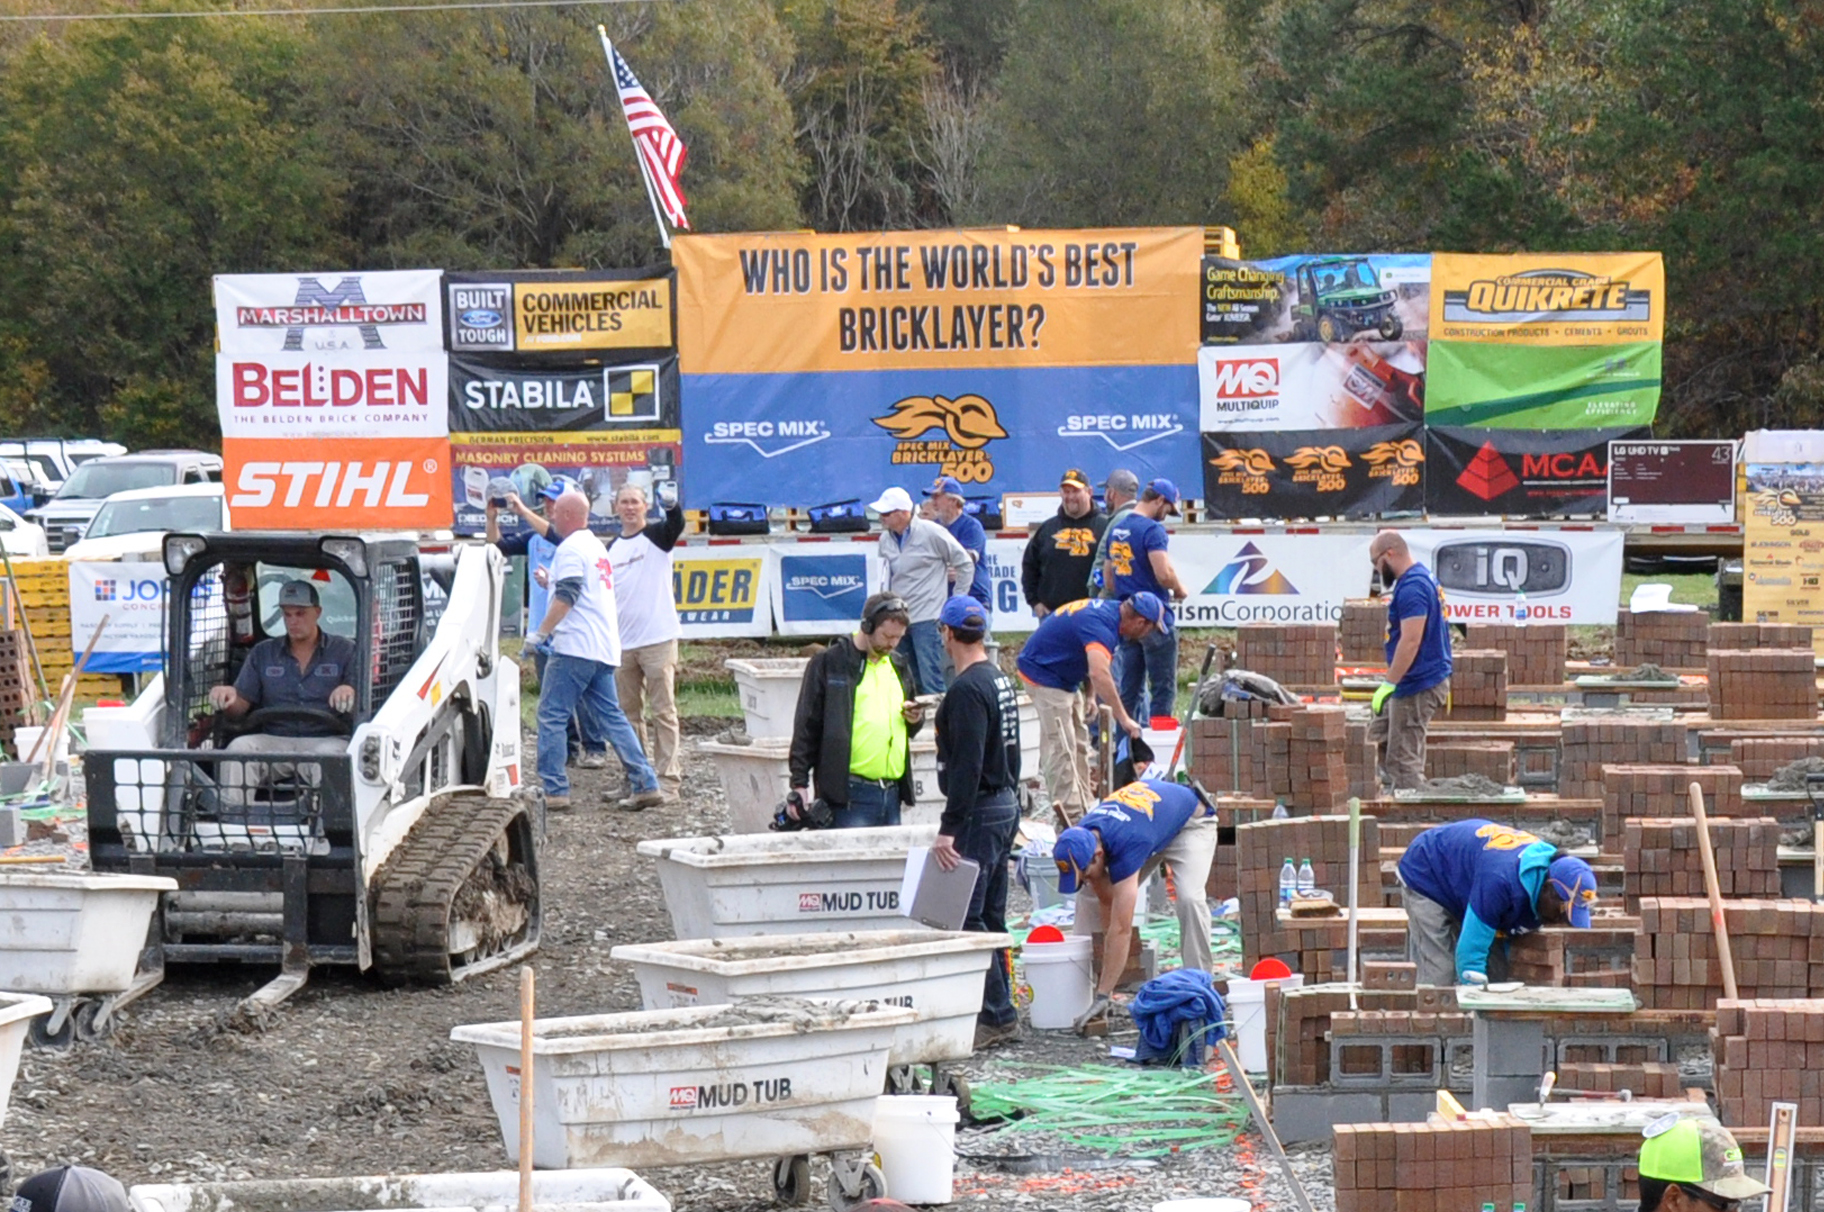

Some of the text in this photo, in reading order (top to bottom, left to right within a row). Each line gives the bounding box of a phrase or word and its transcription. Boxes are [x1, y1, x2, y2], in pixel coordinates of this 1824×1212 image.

[740, 241, 1137, 294] WHO IS THE WORLD'S BEST
[1207, 266, 1285, 287] Game Changing
[1496, 275, 1569, 288] COMMERCIAL
[456, 291, 505, 309] BUILT
[522, 290, 663, 313] COMMERCIAL
[1206, 285, 1281, 303] Craftsmanship.
[1467, 281, 1629, 312] QUIKRETE
[240, 305, 424, 325] MARSHALLTOWN
[523, 312, 622, 333] VEHICLES
[459, 329, 506, 343] TOUGH
[839, 303, 1046, 353] BRICKLAYER?
[1443, 327, 1506, 337] CONSTRUCTION
[1507, 327, 1550, 337] PRODUCTS
[1617, 327, 1648, 336] GROUTS
[232, 361, 428, 407] BELDEN
[1216, 359, 1280, 397] MQ
[465, 380, 595, 410] STABILA
[1217, 399, 1279, 412] MULTIQUIP
[234, 413, 429, 424] THE BELDEN BRICK COMPANY
[1066, 414, 1172, 431] SPEC MIX
[714, 420, 820, 437] SPEC MIX
[469, 435, 554, 444] GERMAN PRECISION
[896, 440, 950, 451] SPEC MIX
[455, 450, 645, 464] MASONRY CLEANING SYSTEMS
[891, 450, 986, 465] BRICKLAYER
[1614, 446, 1626, 456] LG
[1627, 446, 1646, 455] UHD
[1647, 446, 1659, 454] TV
[1711, 446, 1731, 462] 43
[940, 460, 994, 484] 500
[1522, 453, 1608, 477] MCA
[230, 461, 429, 507] STIHL
[1317, 478, 1346, 492] 500
[1392, 471, 1420, 486] 500
[1242, 481, 1270, 494] 500
[1771, 515, 1797, 526] 500
[988, 566, 1016, 578] RADE
[1476, 548, 1528, 591] iQ
[790, 575, 857, 587] SPEC MIX
[1445, 604, 1500, 617] OWER
[799, 891, 899, 911] MQ MUD TUB
[670, 1078, 792, 1108] MQ MUD TUB
